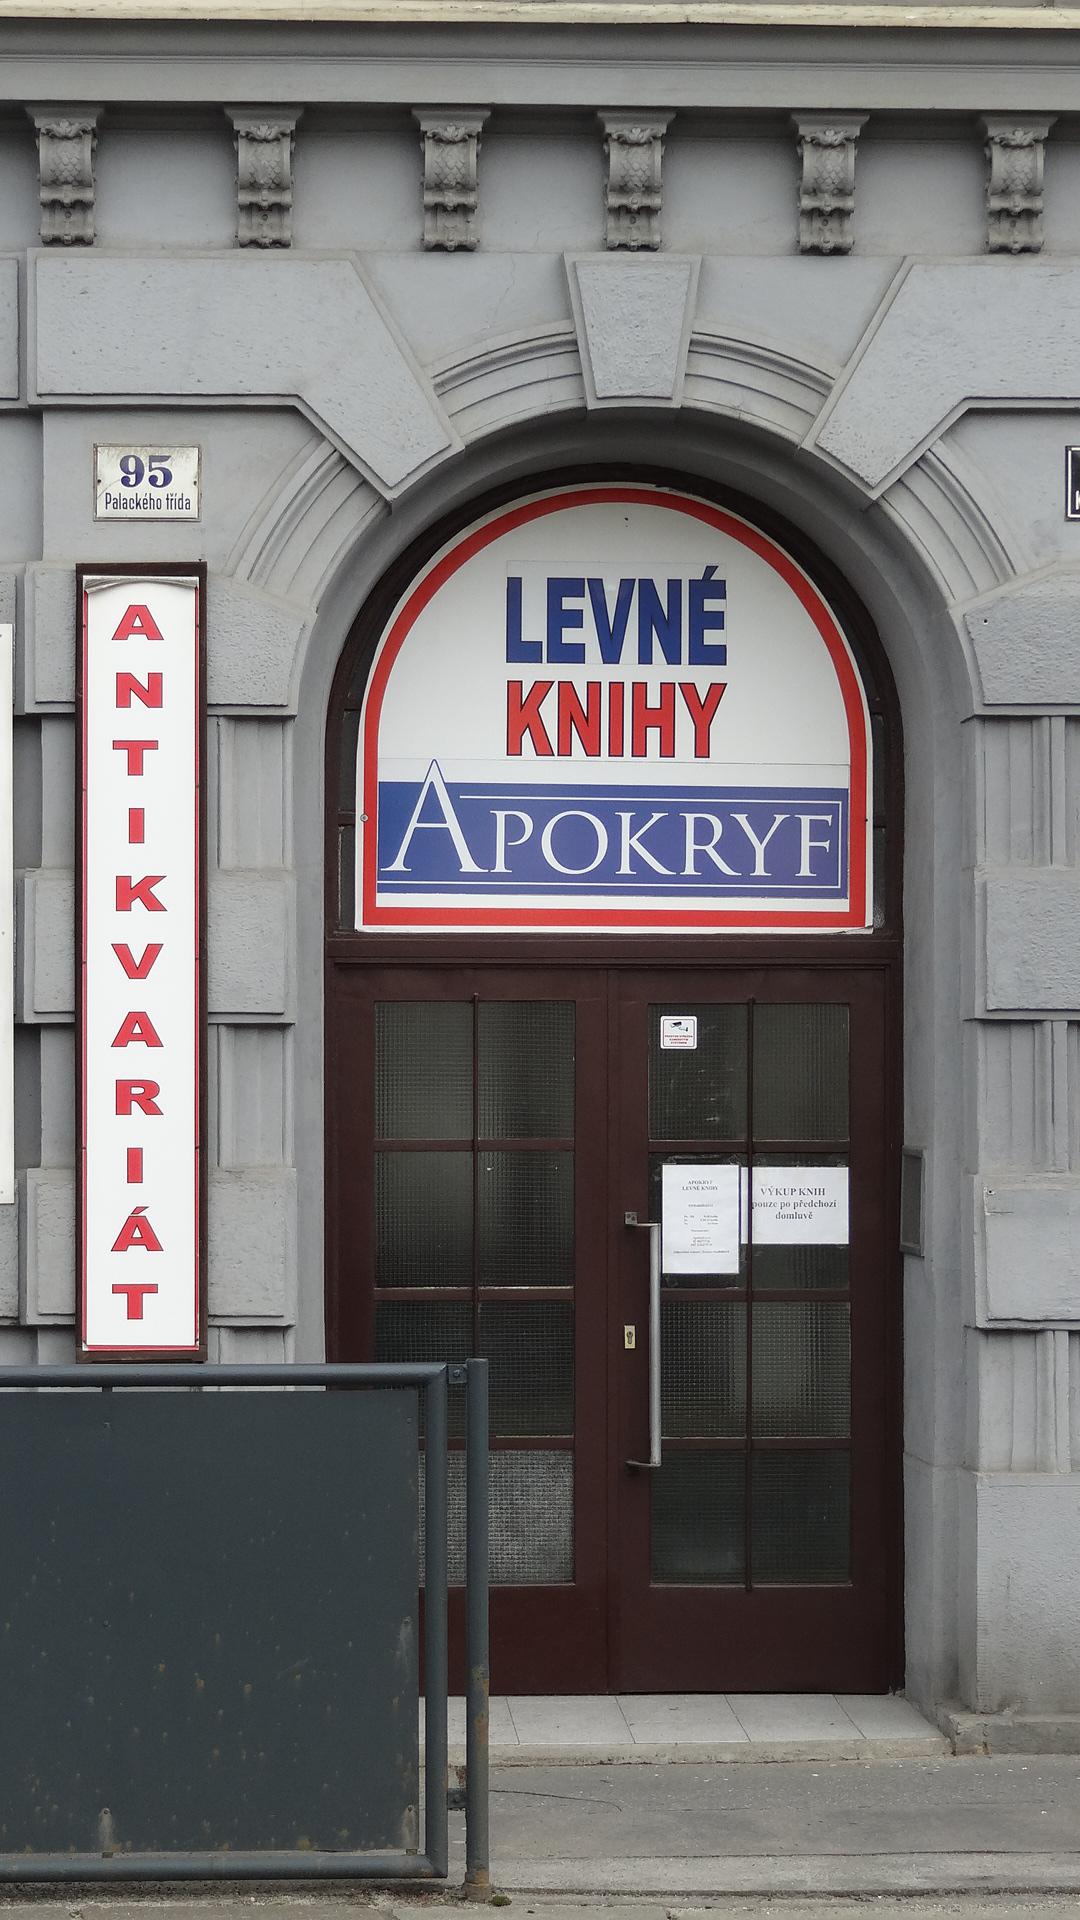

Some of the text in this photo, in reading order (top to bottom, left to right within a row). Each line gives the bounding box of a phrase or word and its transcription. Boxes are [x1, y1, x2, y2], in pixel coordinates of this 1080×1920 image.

[119, 454, 173, 488] 95
[105, 492, 191, 511] Palackého třída
[505, 565, 728, 666] LEVNÉ
[505, 680, 728, 759] KNIHY
[380, 758, 833, 878] APOKRYF
[111, 604, 168, 1320] ANTIKVARIÁT
[752, 1199, 837, 1210] pouze po předchozí
[760, 1185, 826, 1196] VÝKUP KNIH
[775, 1211, 813, 1220] domluvě
